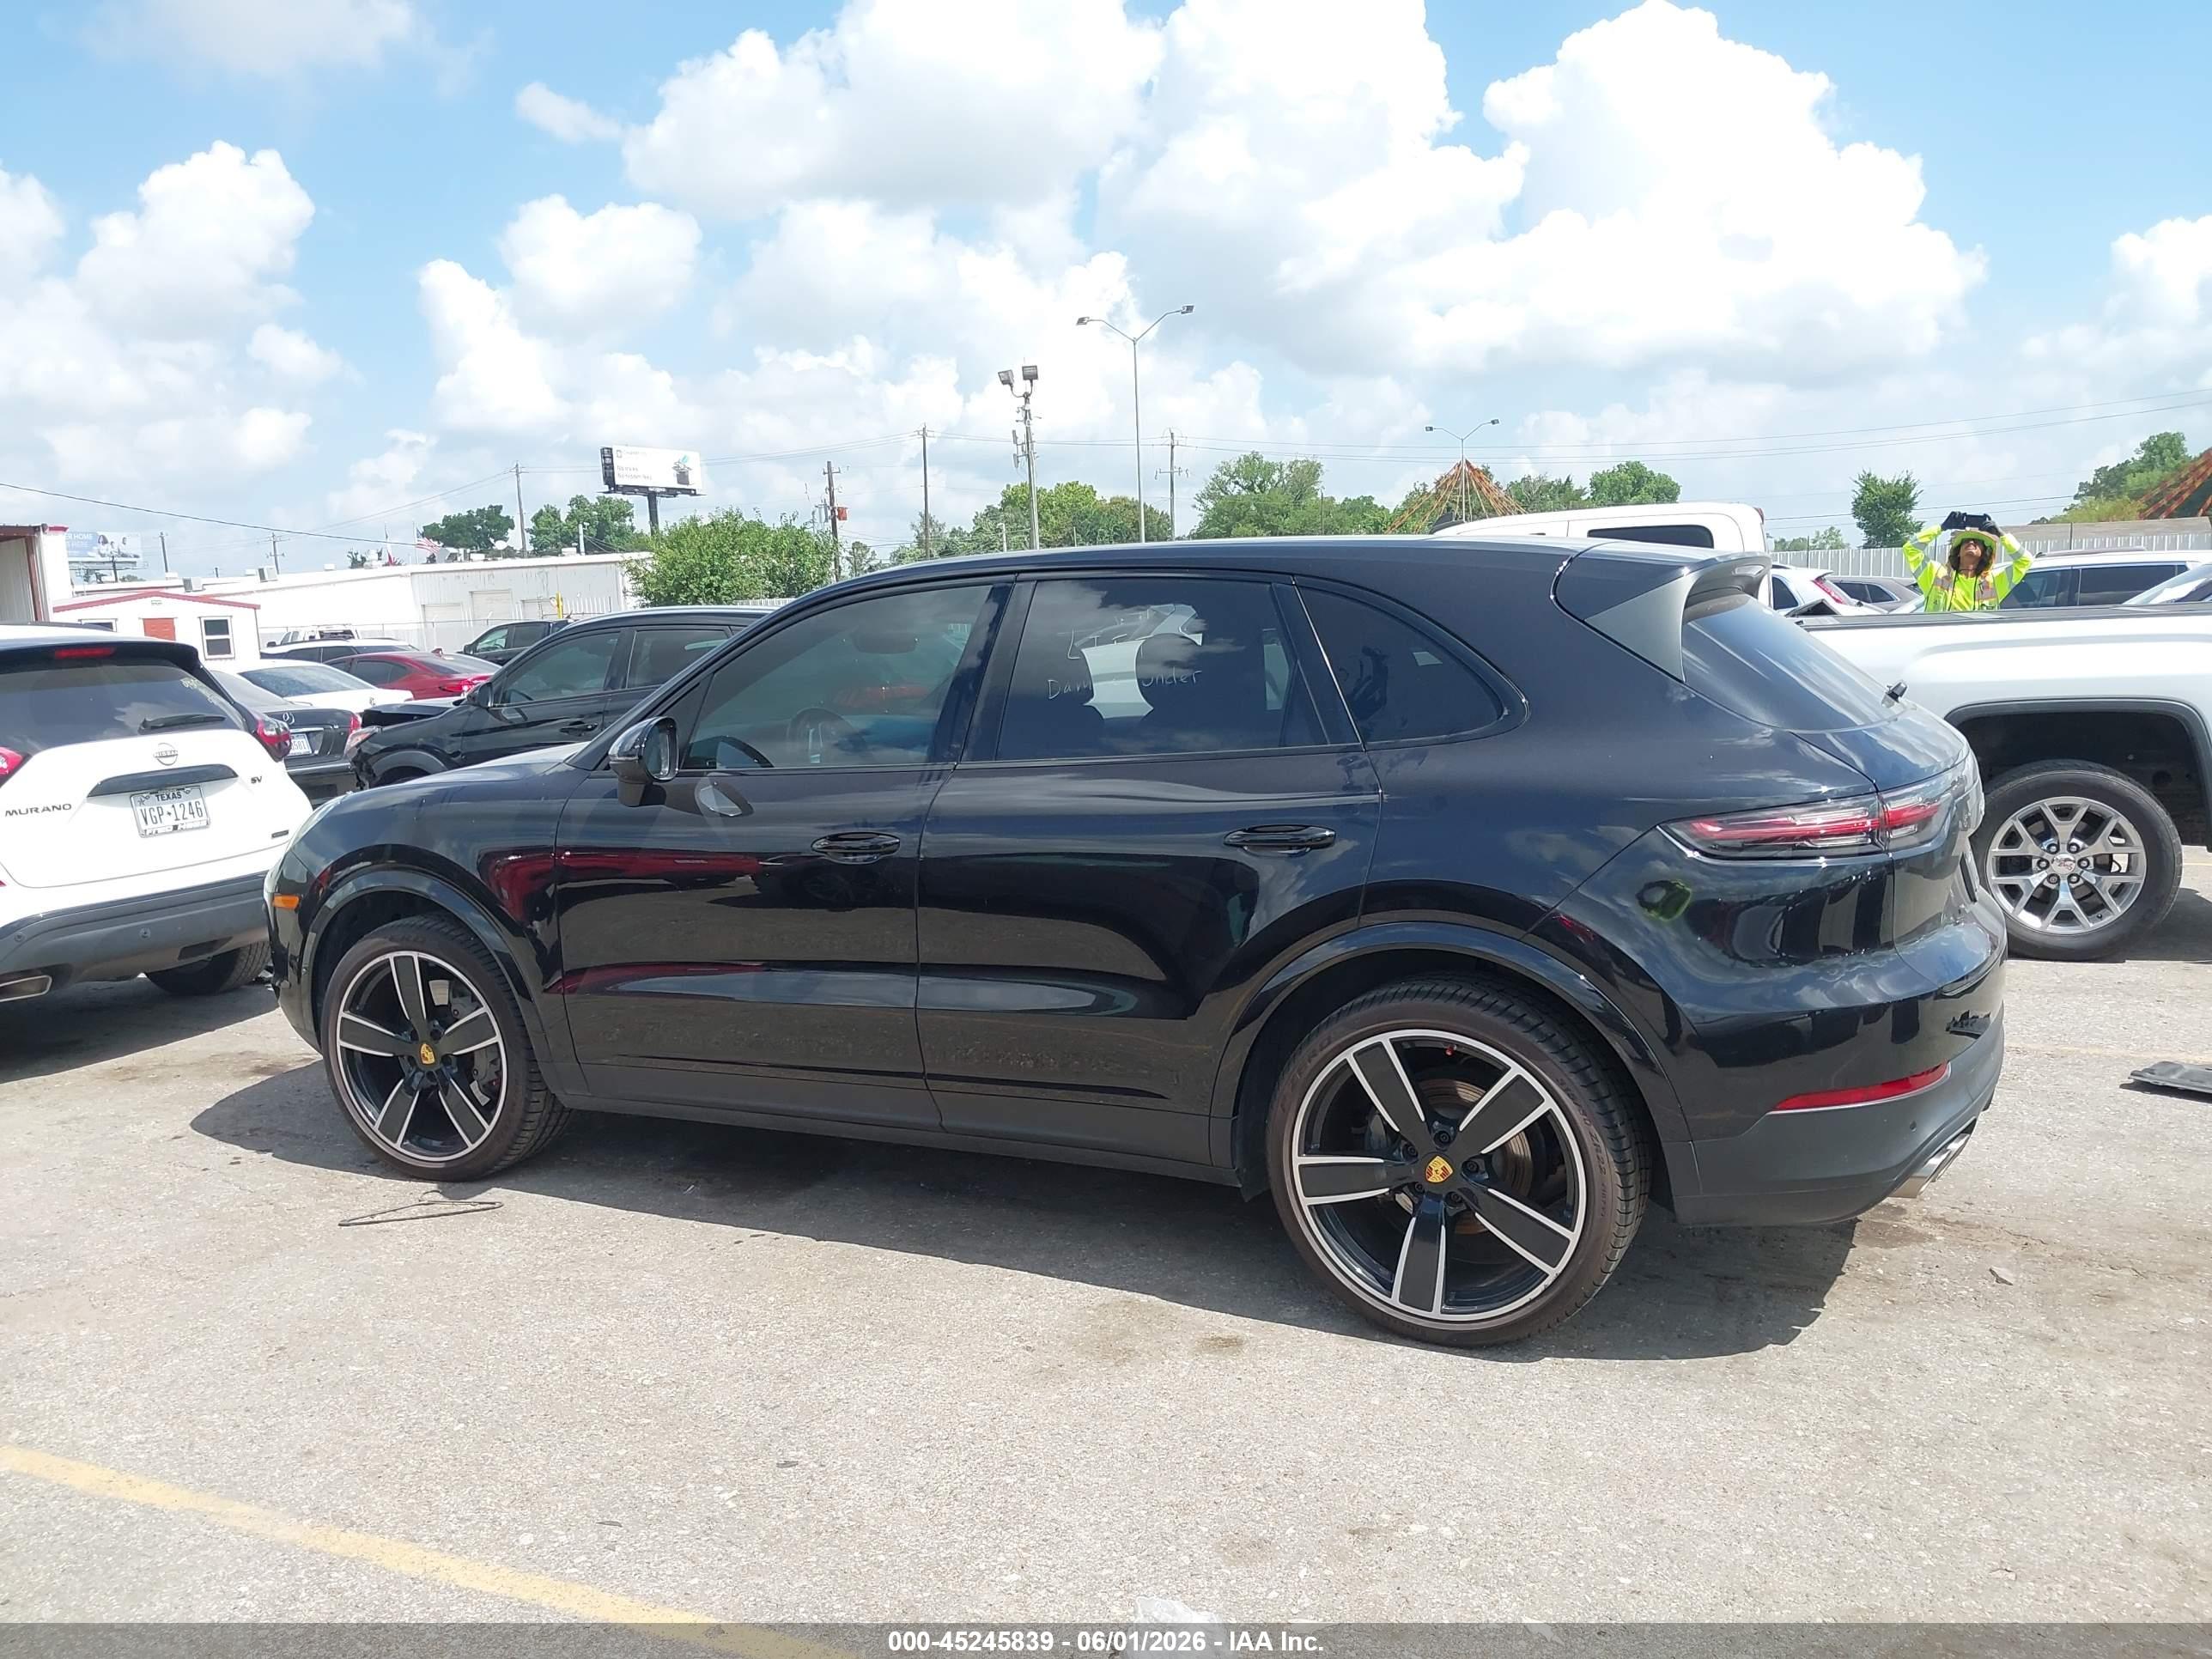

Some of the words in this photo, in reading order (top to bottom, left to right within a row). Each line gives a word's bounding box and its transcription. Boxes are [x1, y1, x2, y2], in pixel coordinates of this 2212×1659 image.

[251, 775, 263, 784] SV
[155, 791, 182, 802] TEXAS
[5, 803, 72, 817] MURANO
